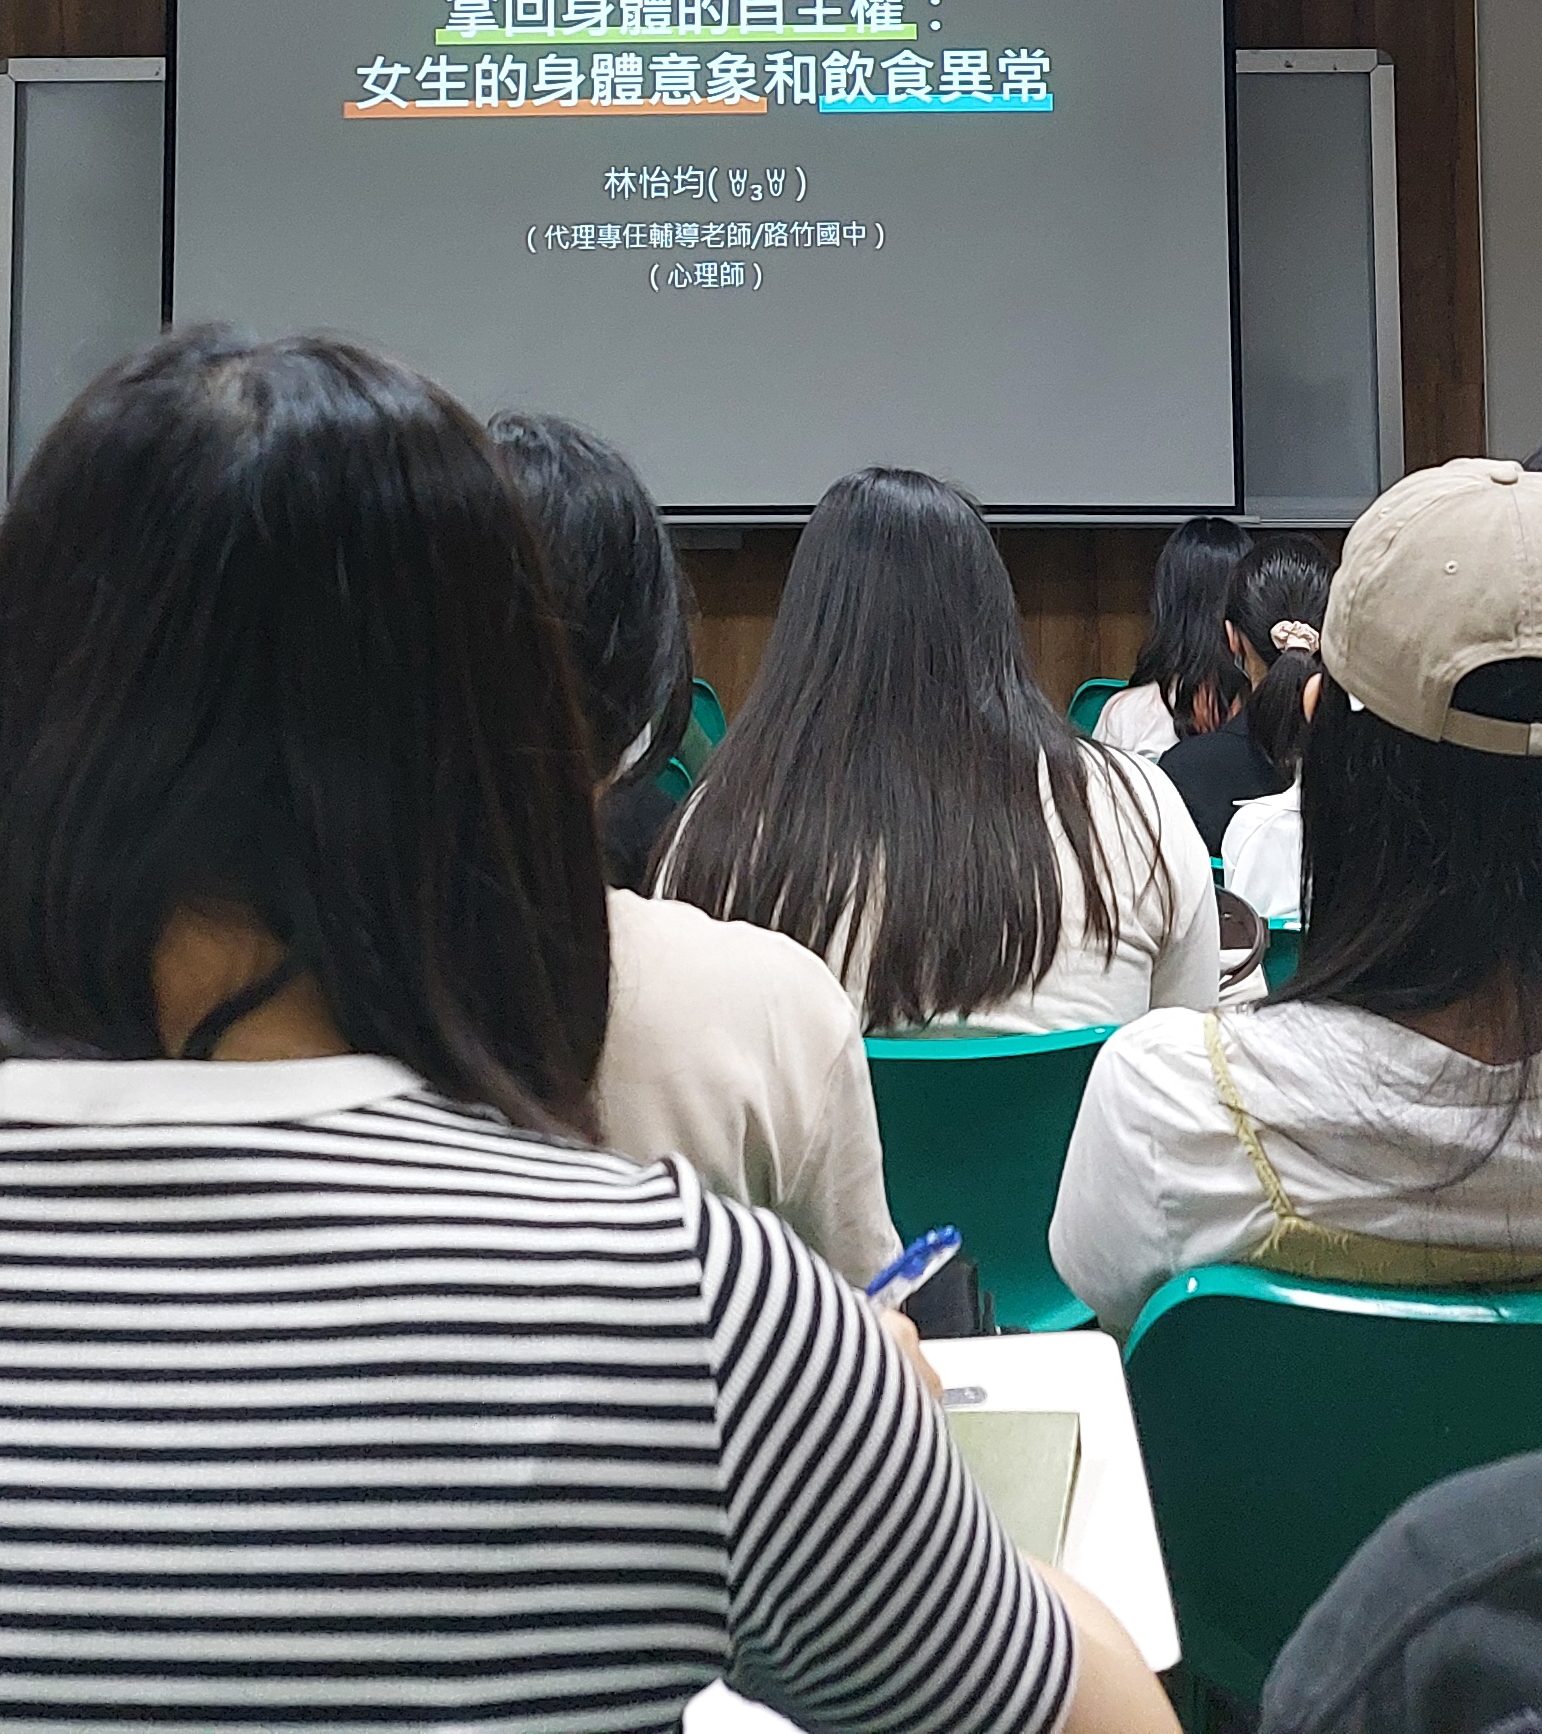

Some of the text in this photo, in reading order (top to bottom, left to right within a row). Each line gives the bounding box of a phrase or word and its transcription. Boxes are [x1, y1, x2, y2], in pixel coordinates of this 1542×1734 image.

[356, 49, 1051, 110] 女生的身體意象和飲食異常
[650, 261, 764, 293] （心理師）
